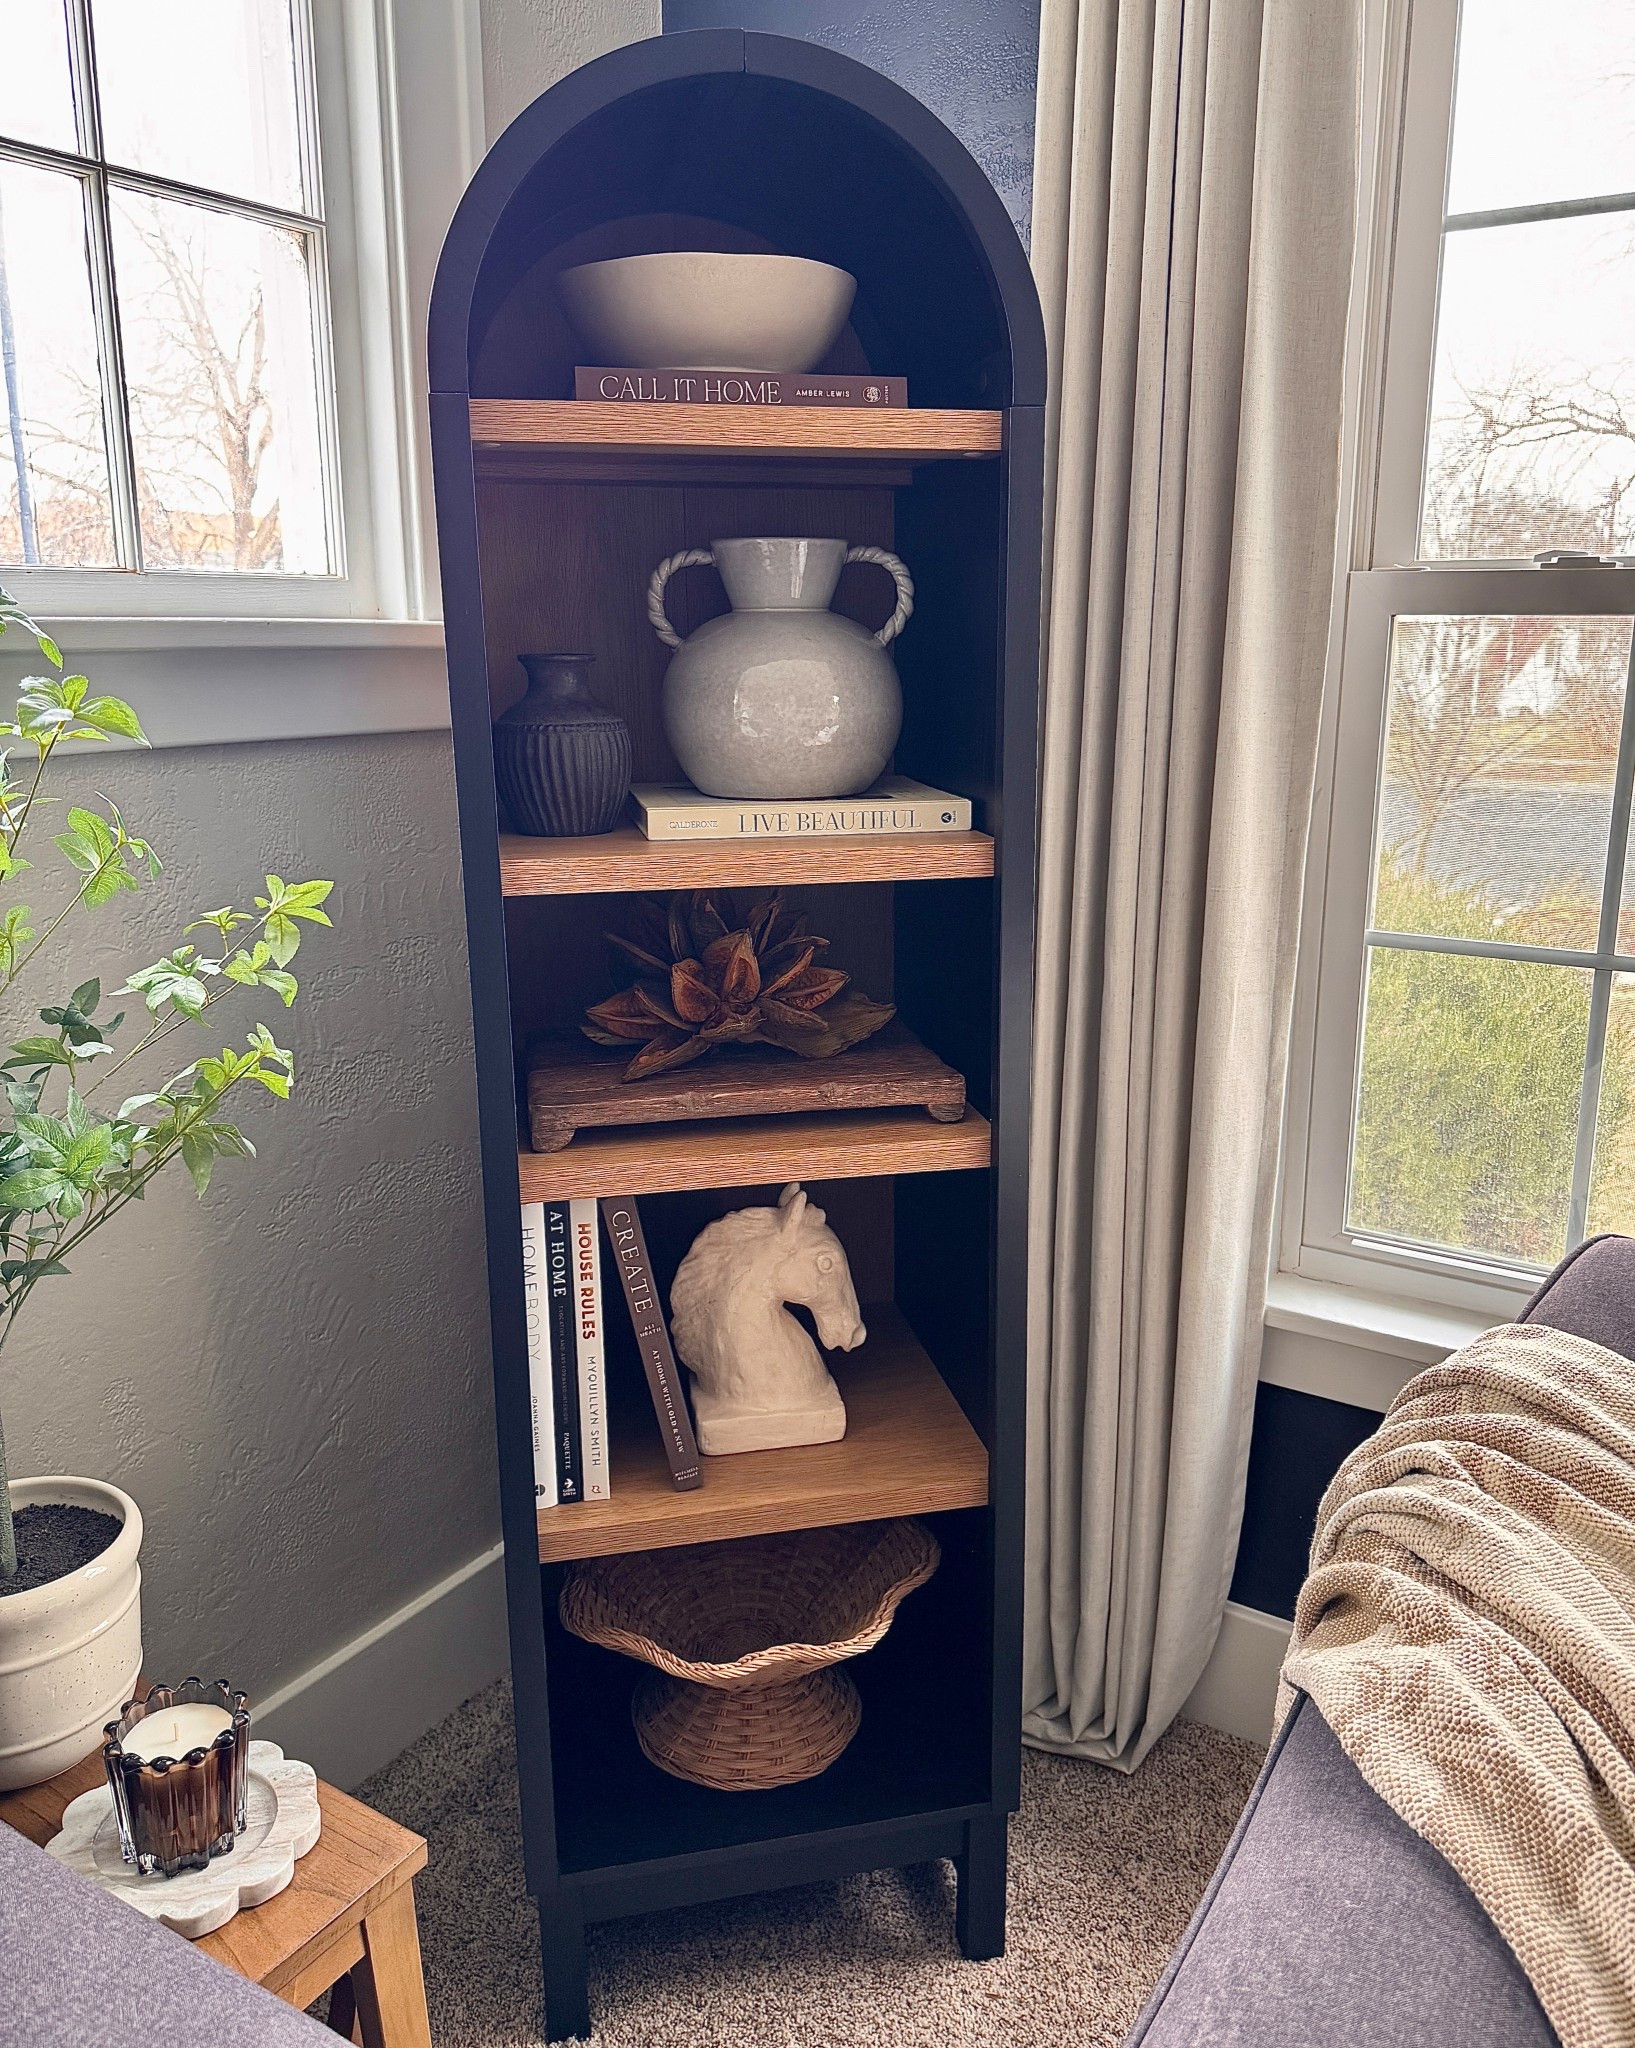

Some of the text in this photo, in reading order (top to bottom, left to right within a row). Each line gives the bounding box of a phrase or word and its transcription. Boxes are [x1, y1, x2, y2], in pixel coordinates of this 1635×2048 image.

[600, 376, 782, 404] CALL IT HOME
[796, 389, 850, 398] AMBER LEWIS
[669, 820, 718, 829] CALDERONE
[738, 810, 922, 833] LIVE BEAUTIFUL
[550, 1211, 566, 1298] AT HOME
[612, 1210, 654, 1313] CREATE
[578, 1222, 596, 1340] HOUSE RULES
[522, 1227, 541, 1360] HOMEBODY
[652, 1350, 660, 1360] AT
[655, 1361, 666, 1385] HOME
[662, 1386, 673, 1409] WITH
[587, 1356, 601, 1466] MYQUILLYN SMITH
[669, 1410, 678, 1428] OLD
[562, 1432, 572, 1470] PAQUETTE
[675, 1435, 684, 1453] NEW
